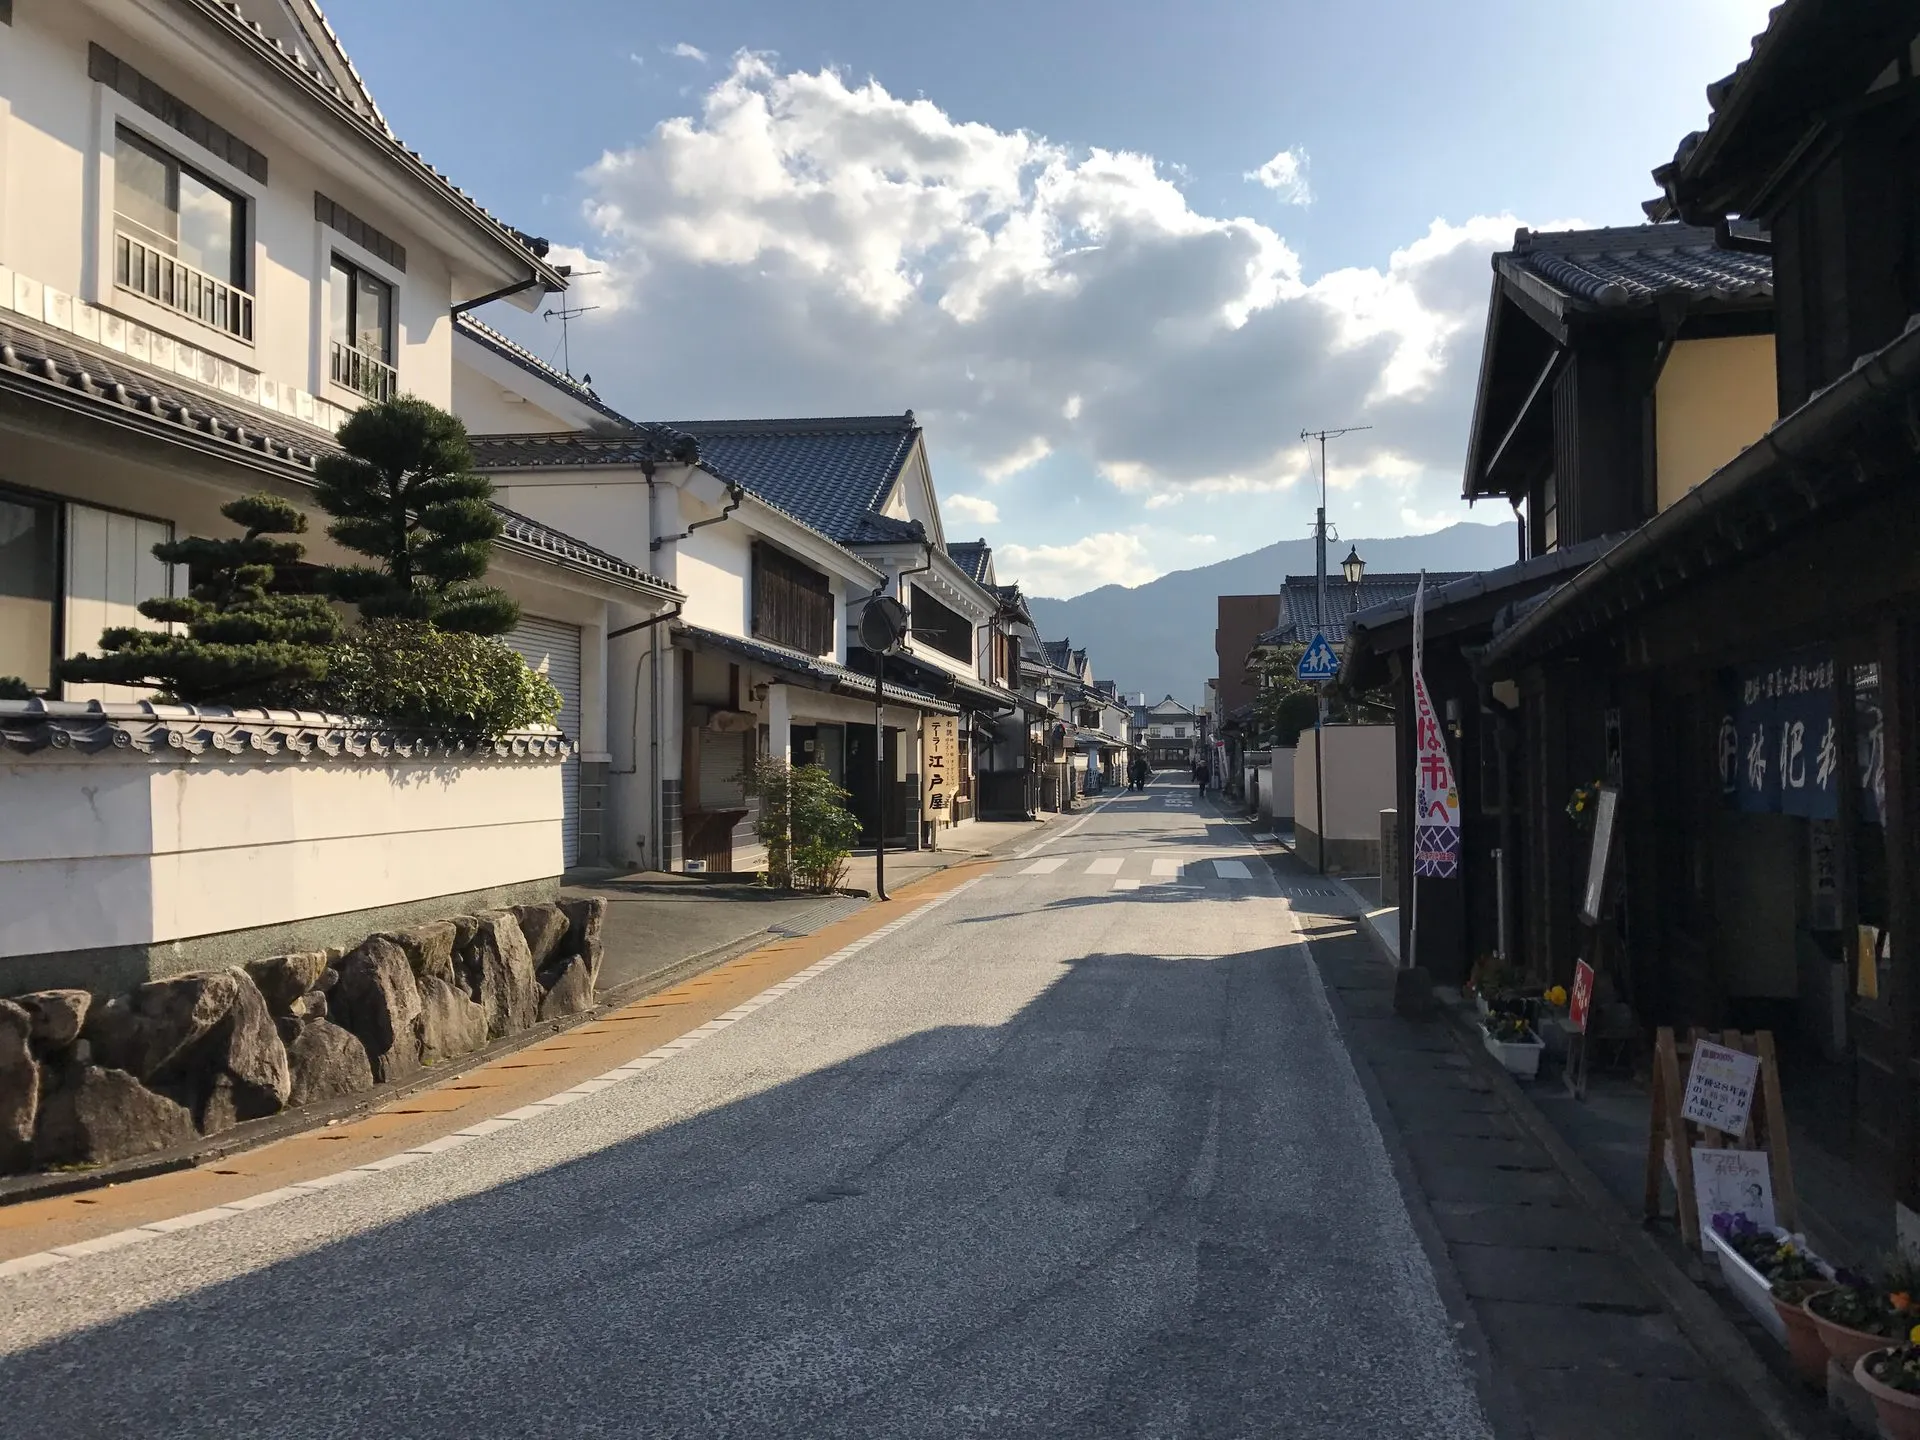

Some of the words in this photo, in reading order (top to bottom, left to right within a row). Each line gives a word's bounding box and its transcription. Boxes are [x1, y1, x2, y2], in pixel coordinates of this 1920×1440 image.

[928, 722, 944, 810] テーラー江戸屋
